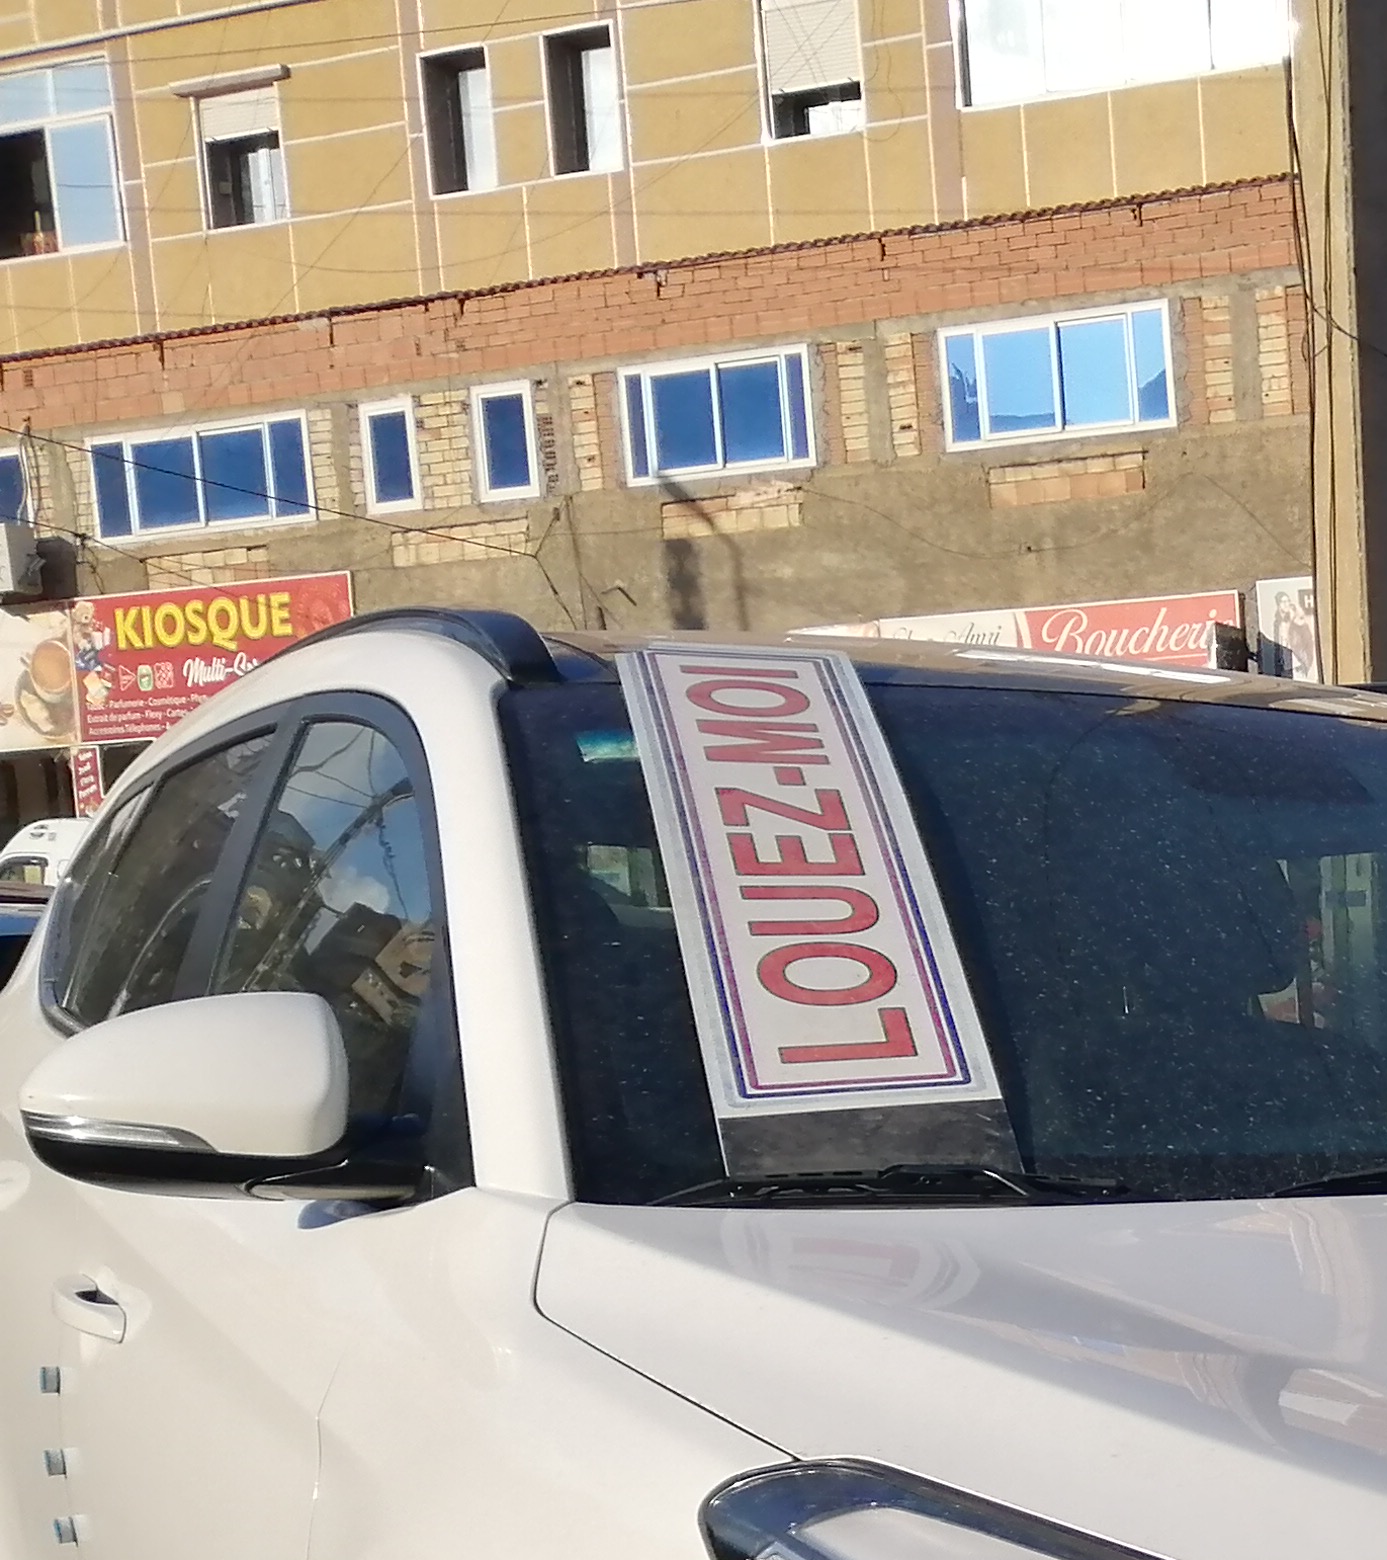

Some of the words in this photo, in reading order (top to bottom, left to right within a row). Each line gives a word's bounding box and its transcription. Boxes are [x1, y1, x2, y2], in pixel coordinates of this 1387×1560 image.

[114, 592, 293, 651] KIOSQUE
[1042, 606, 1234, 656] Boucheri
[681, 665, 918, 1064] LOUEZ-MOI
